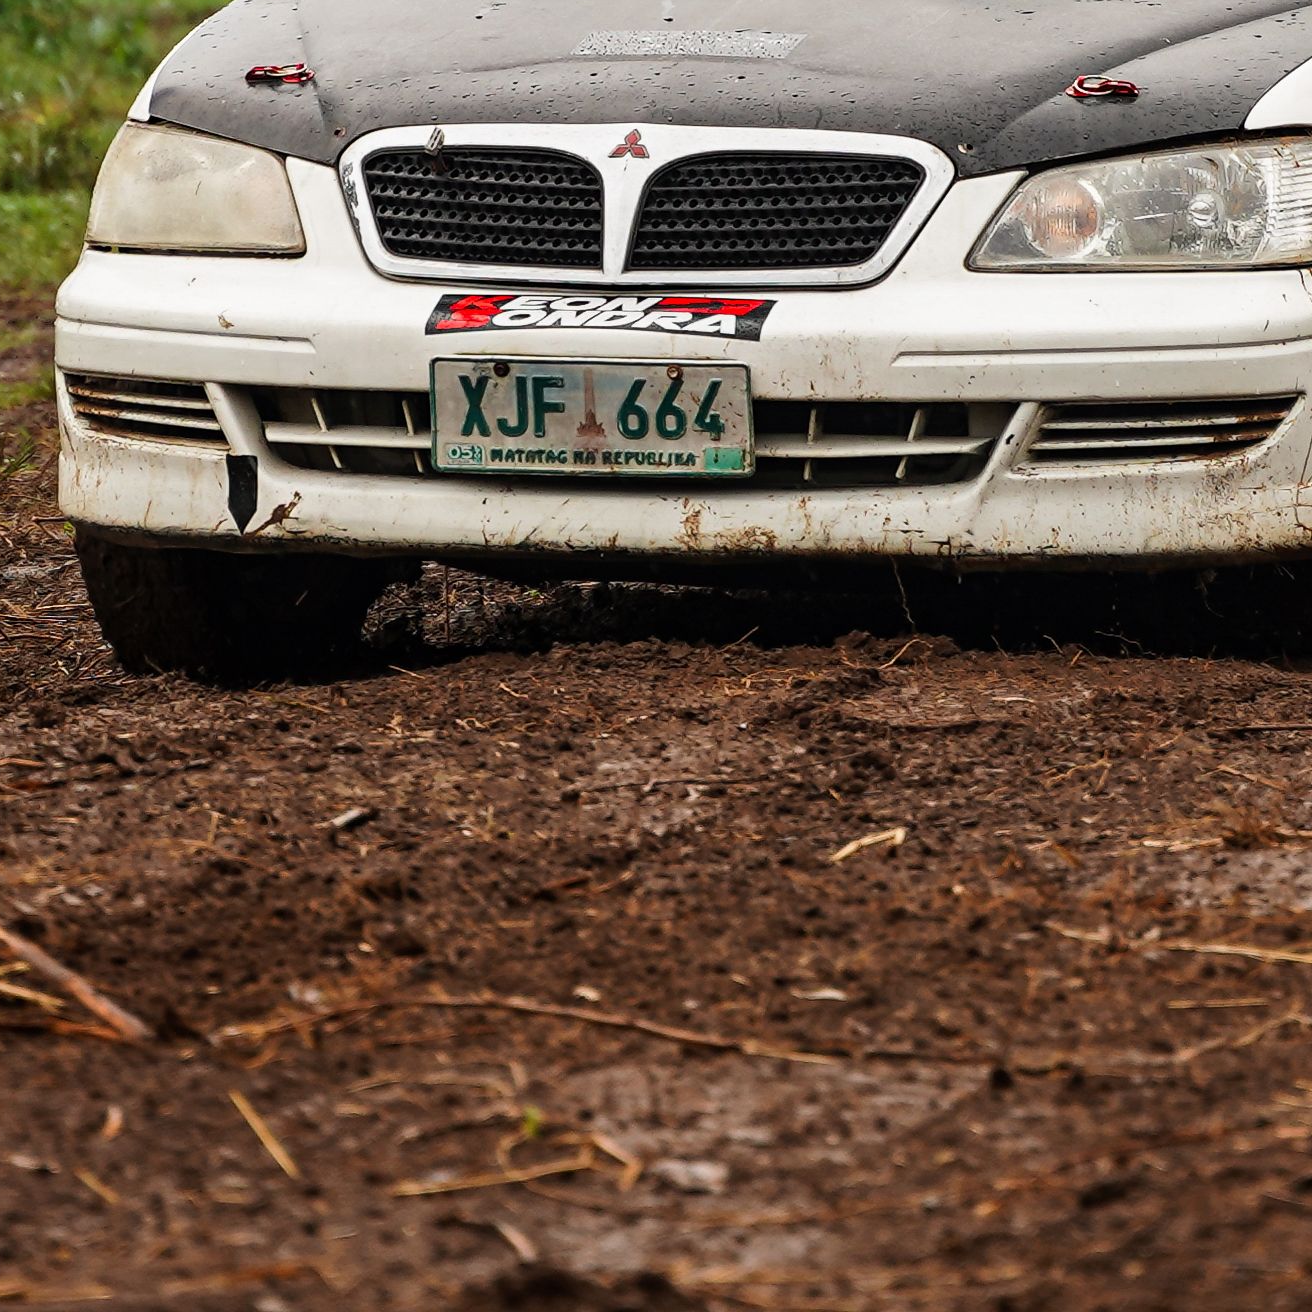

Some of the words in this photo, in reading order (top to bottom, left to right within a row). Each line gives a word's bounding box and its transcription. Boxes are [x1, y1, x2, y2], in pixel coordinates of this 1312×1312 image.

[449, 296, 663, 315] KEON
[435, 310, 737, 336] SONDRA
[458, 375, 566, 439] XJF
[617, 378, 725, 441] 664
